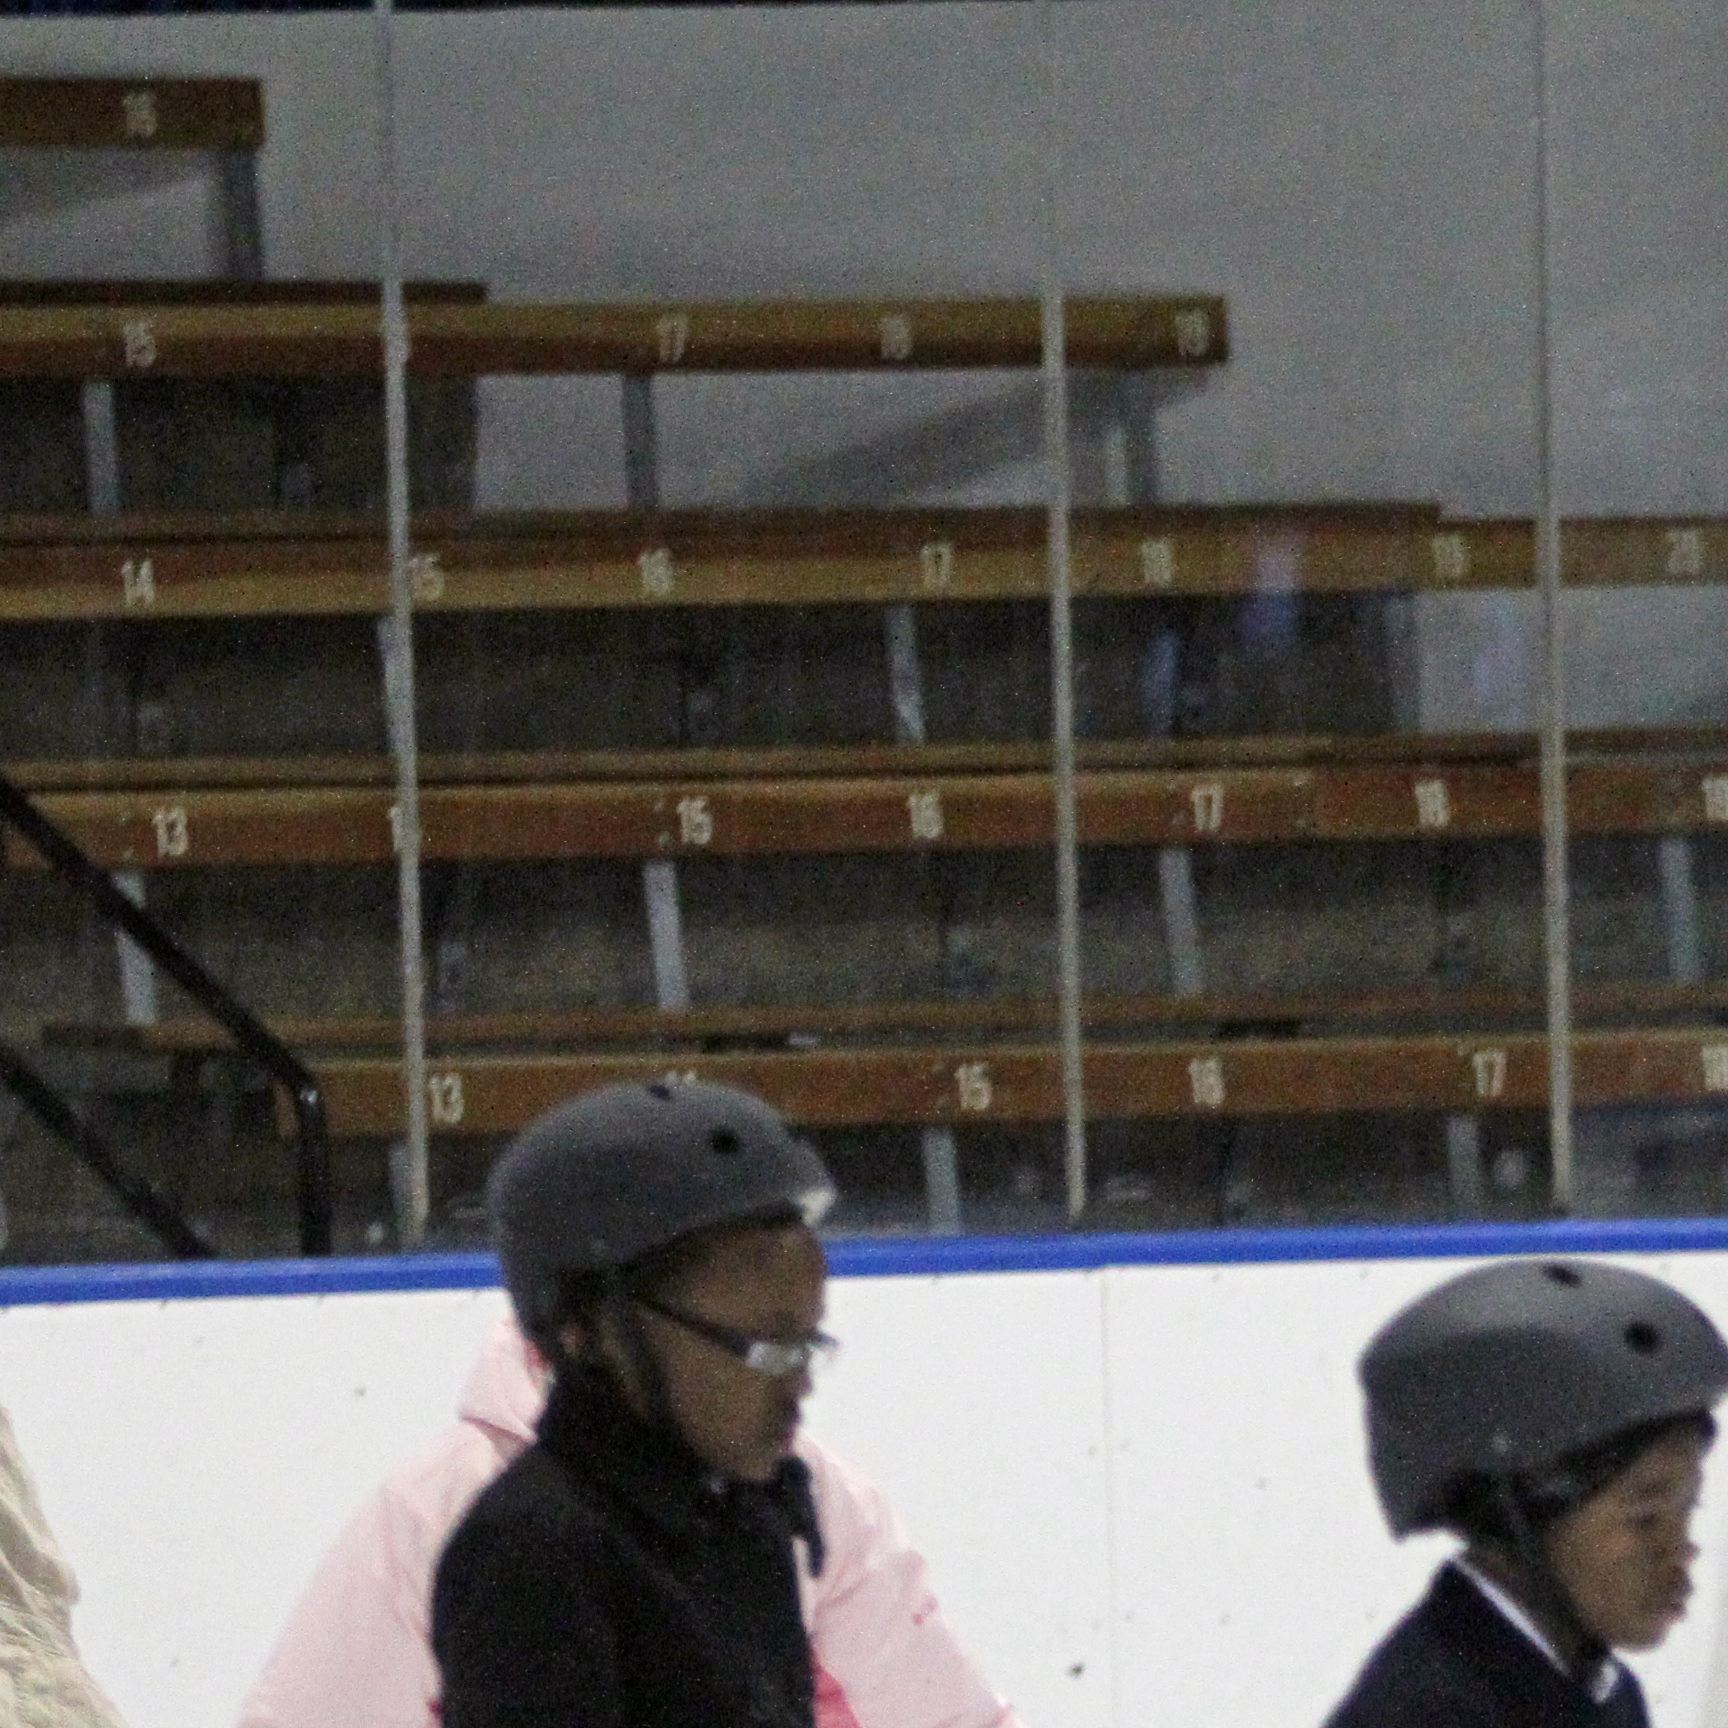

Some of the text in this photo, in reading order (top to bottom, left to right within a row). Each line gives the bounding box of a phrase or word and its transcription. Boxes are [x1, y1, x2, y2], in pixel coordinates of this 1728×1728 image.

[121, 558, 156, 607] 14
[407, 552, 444, 601] 15
[920, 542, 953, 590] 17
[152, 807, 189, 859] 13
[676, 796, 712, 844] 15
[907, 790, 944, 839] 16
[1190, 784, 1224, 833] 17
[429, 1073, 464, 1123] 13
[954, 1064, 991, 1112] 15
[1473, 1049, 1507, 1098] 17
